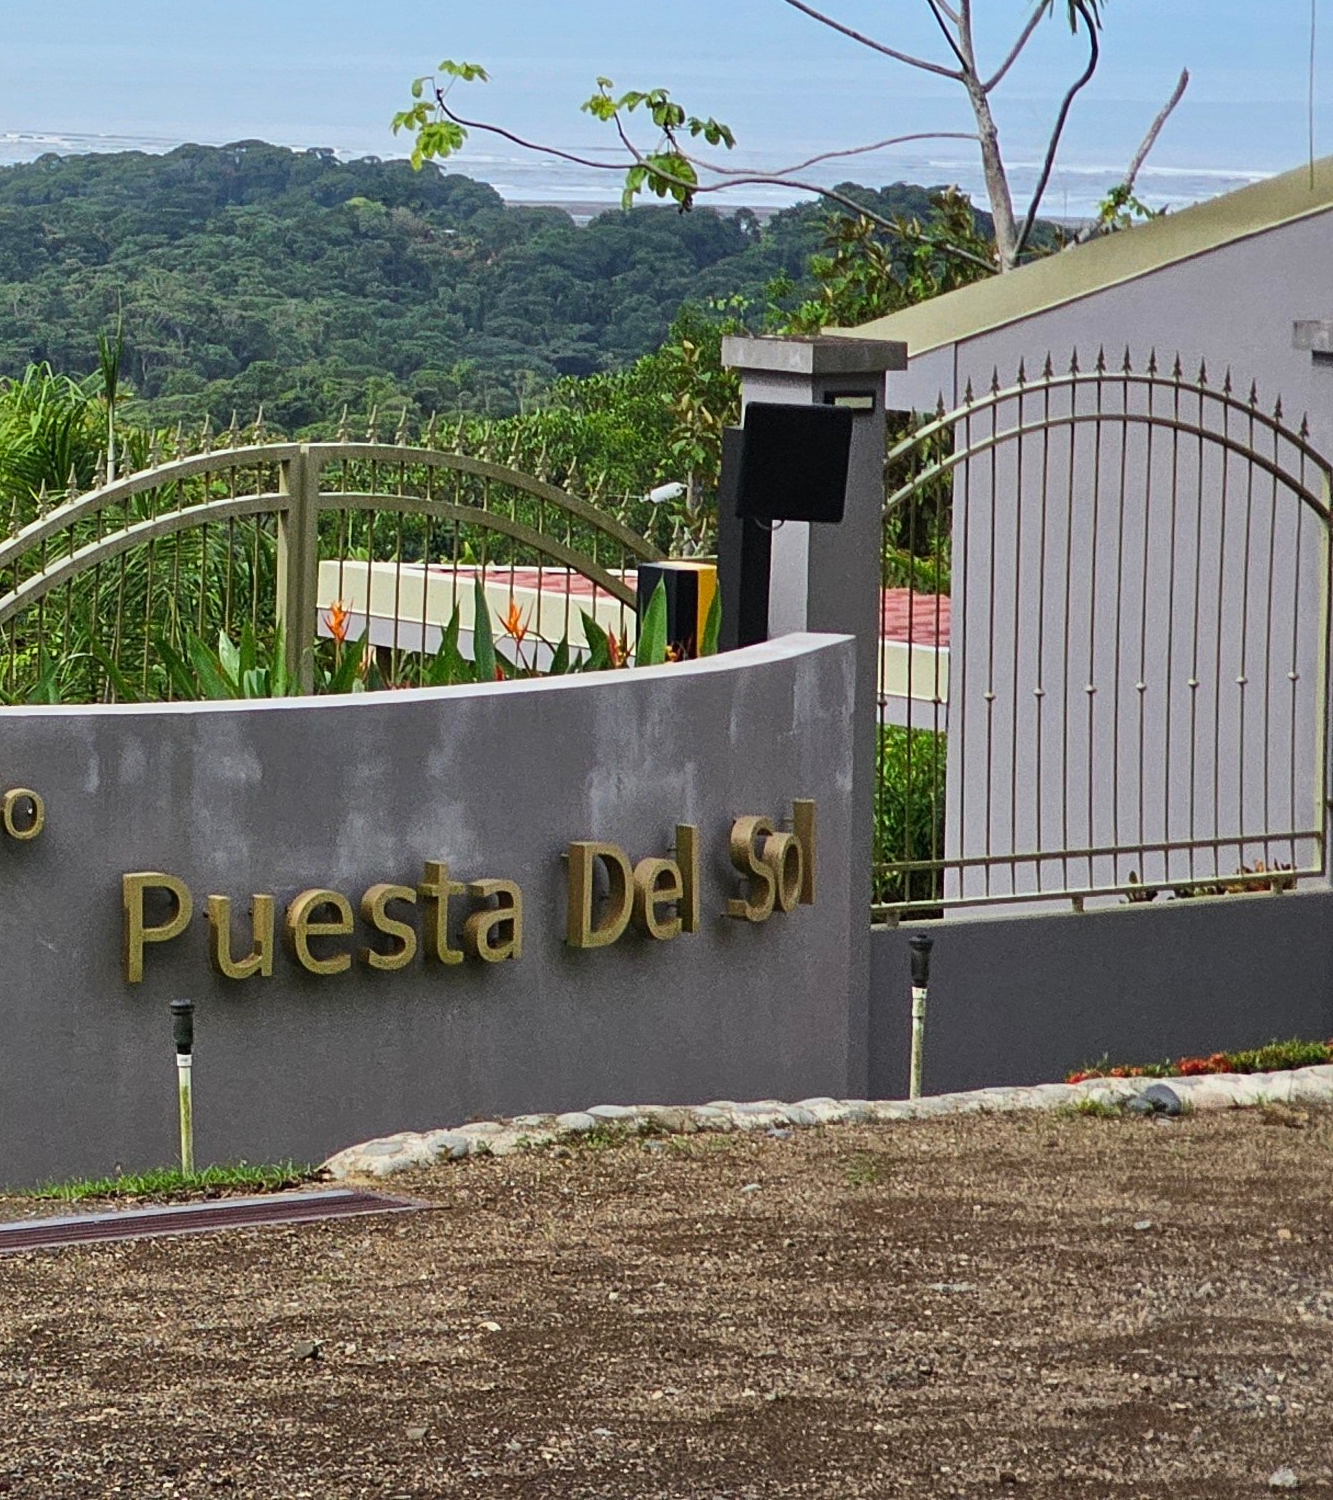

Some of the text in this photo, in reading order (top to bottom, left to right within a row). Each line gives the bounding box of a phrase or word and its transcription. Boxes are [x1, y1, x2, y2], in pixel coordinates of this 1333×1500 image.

[122, 798, 816, 983] Puesta Del Sol
